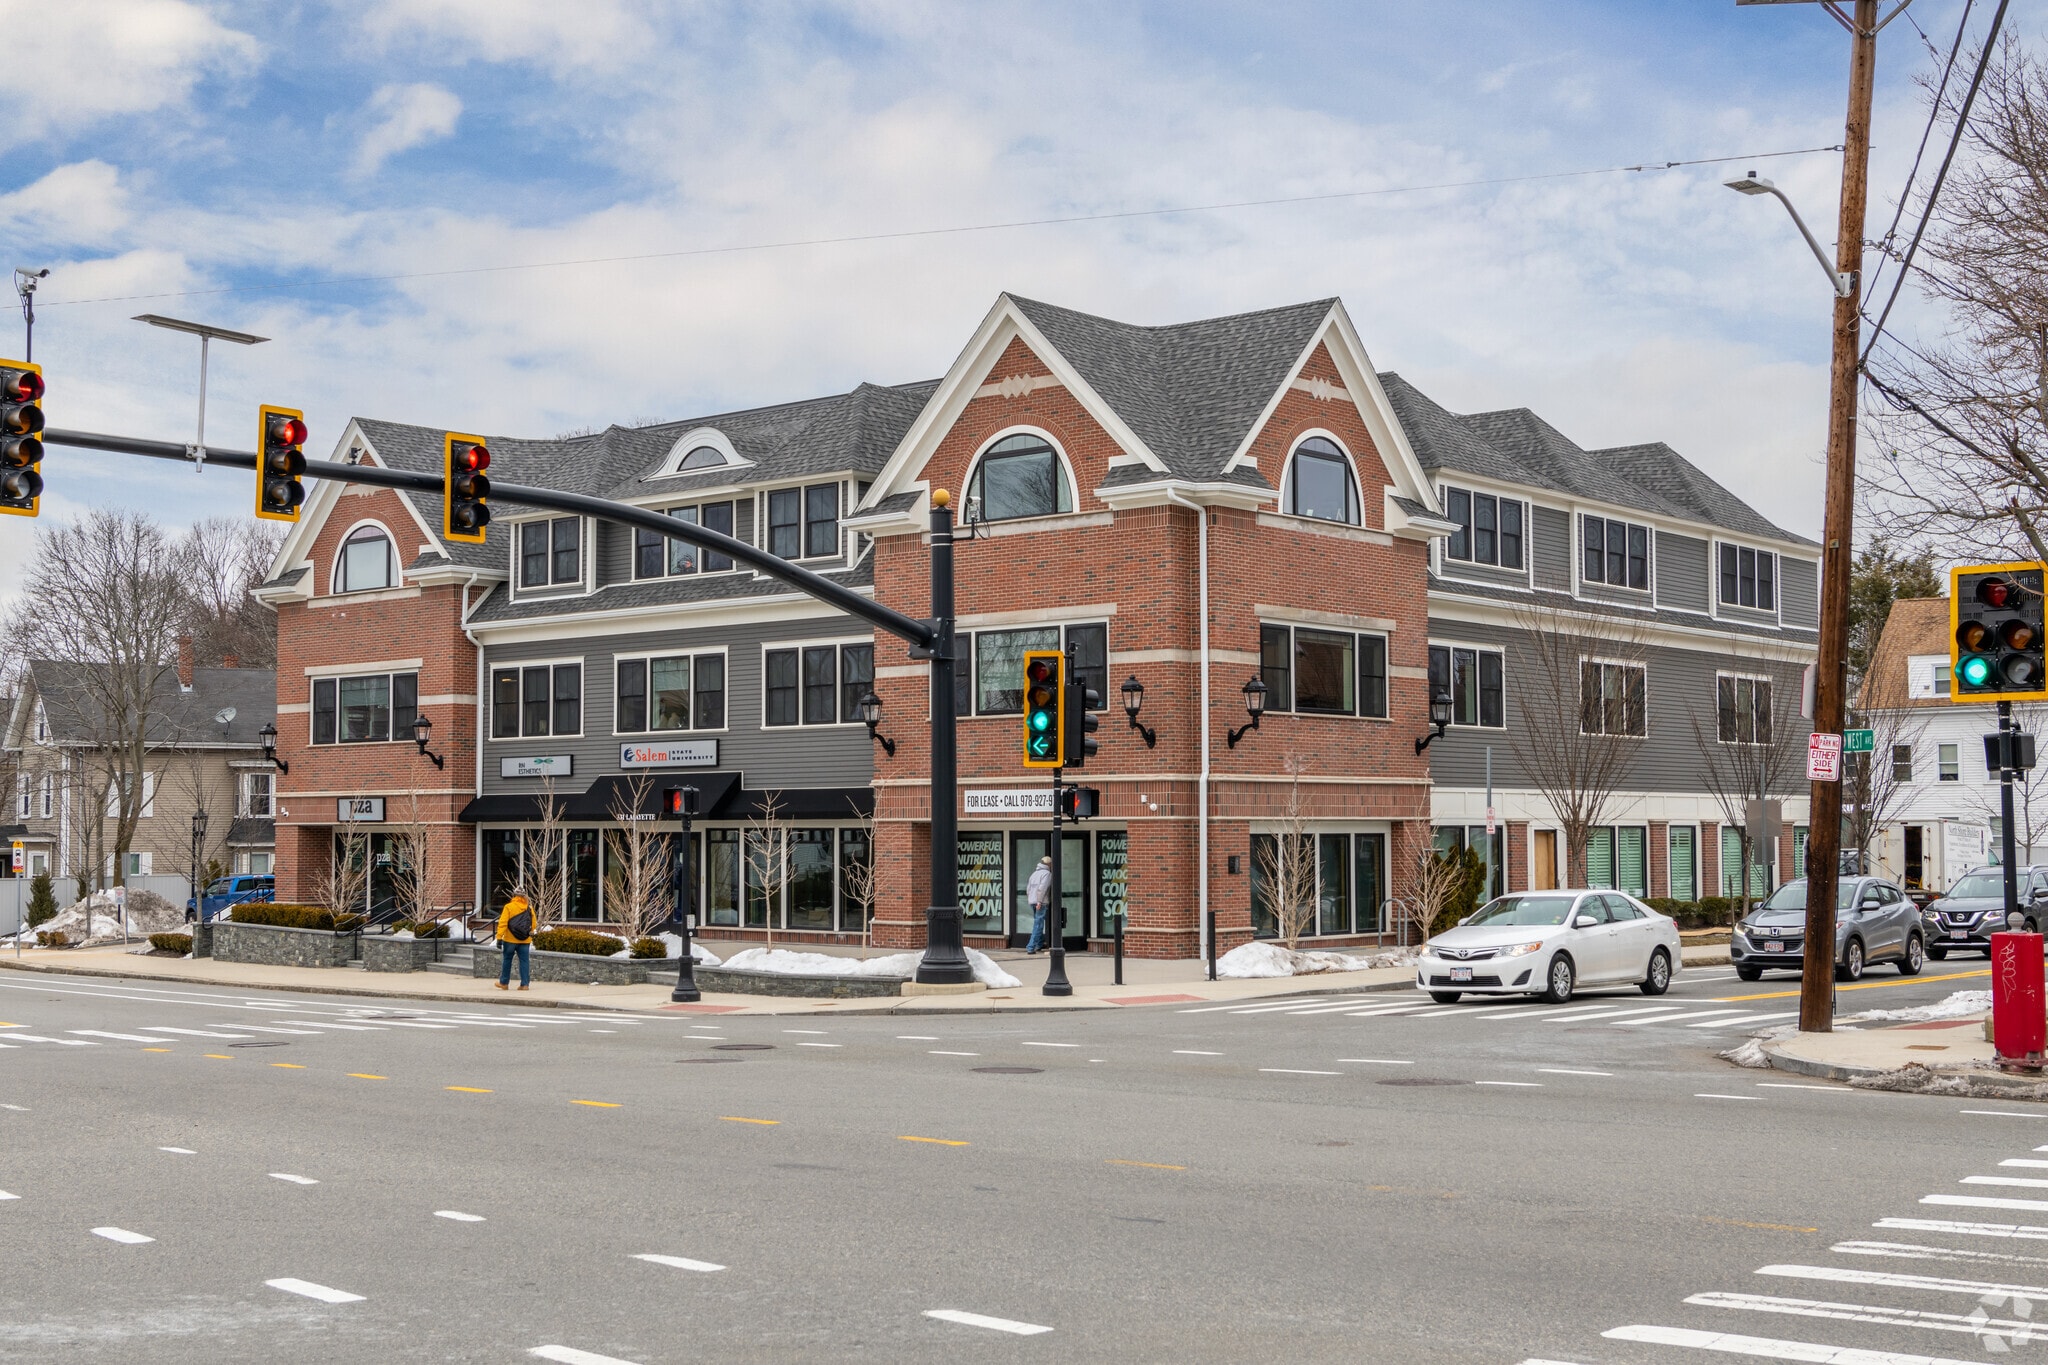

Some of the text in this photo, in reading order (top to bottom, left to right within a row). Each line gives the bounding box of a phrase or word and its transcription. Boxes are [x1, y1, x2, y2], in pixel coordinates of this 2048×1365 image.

[1810, 735, 1839, 748] NO PARKNG
[1847, 732, 1863, 749] WEST
[635, 748, 667, 762] Salem
[1811, 750, 1837, 760] EITHER
[1814, 759, 1833, 767] SIDE
[518, 767, 542, 775] ESTHETICS
[967, 795, 979, 807] FOR
[980, 795, 999, 807] LEASE
[1004, 795, 1019, 807] CALL
[625, 813, 656, 821] LAAYETTE
[957, 841, 1002, 852] POWERFUEL
[957, 853, 1002, 865] NUTRITION
[957, 869, 1002, 880] SMOOTHIES
[957, 882, 1002, 897] COMING
[959, 898, 1002, 917] SOON!
